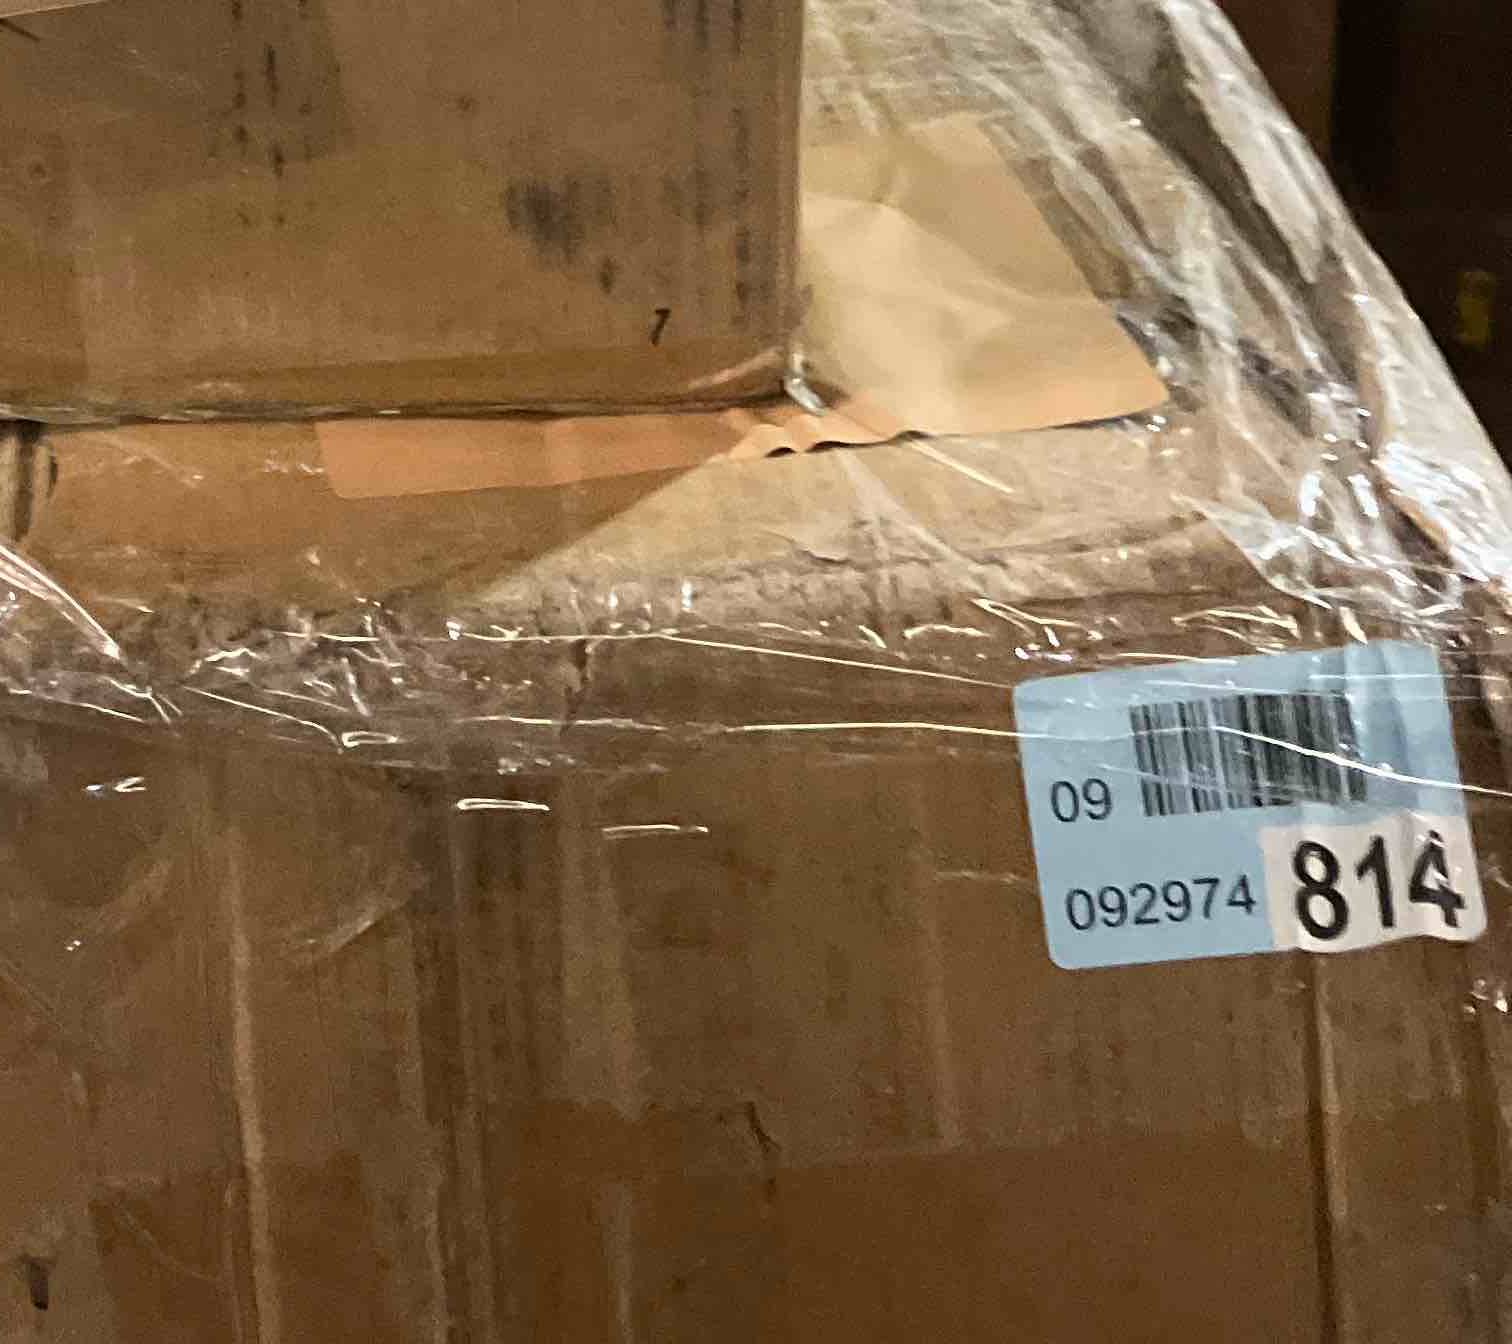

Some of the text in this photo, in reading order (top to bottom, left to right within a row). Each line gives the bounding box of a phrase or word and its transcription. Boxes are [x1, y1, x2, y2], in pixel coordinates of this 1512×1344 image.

[1050, 778, 1112, 823] 09
[1065, 874, 1256, 930] 092974
[1293, 831, 1466, 940] 814
